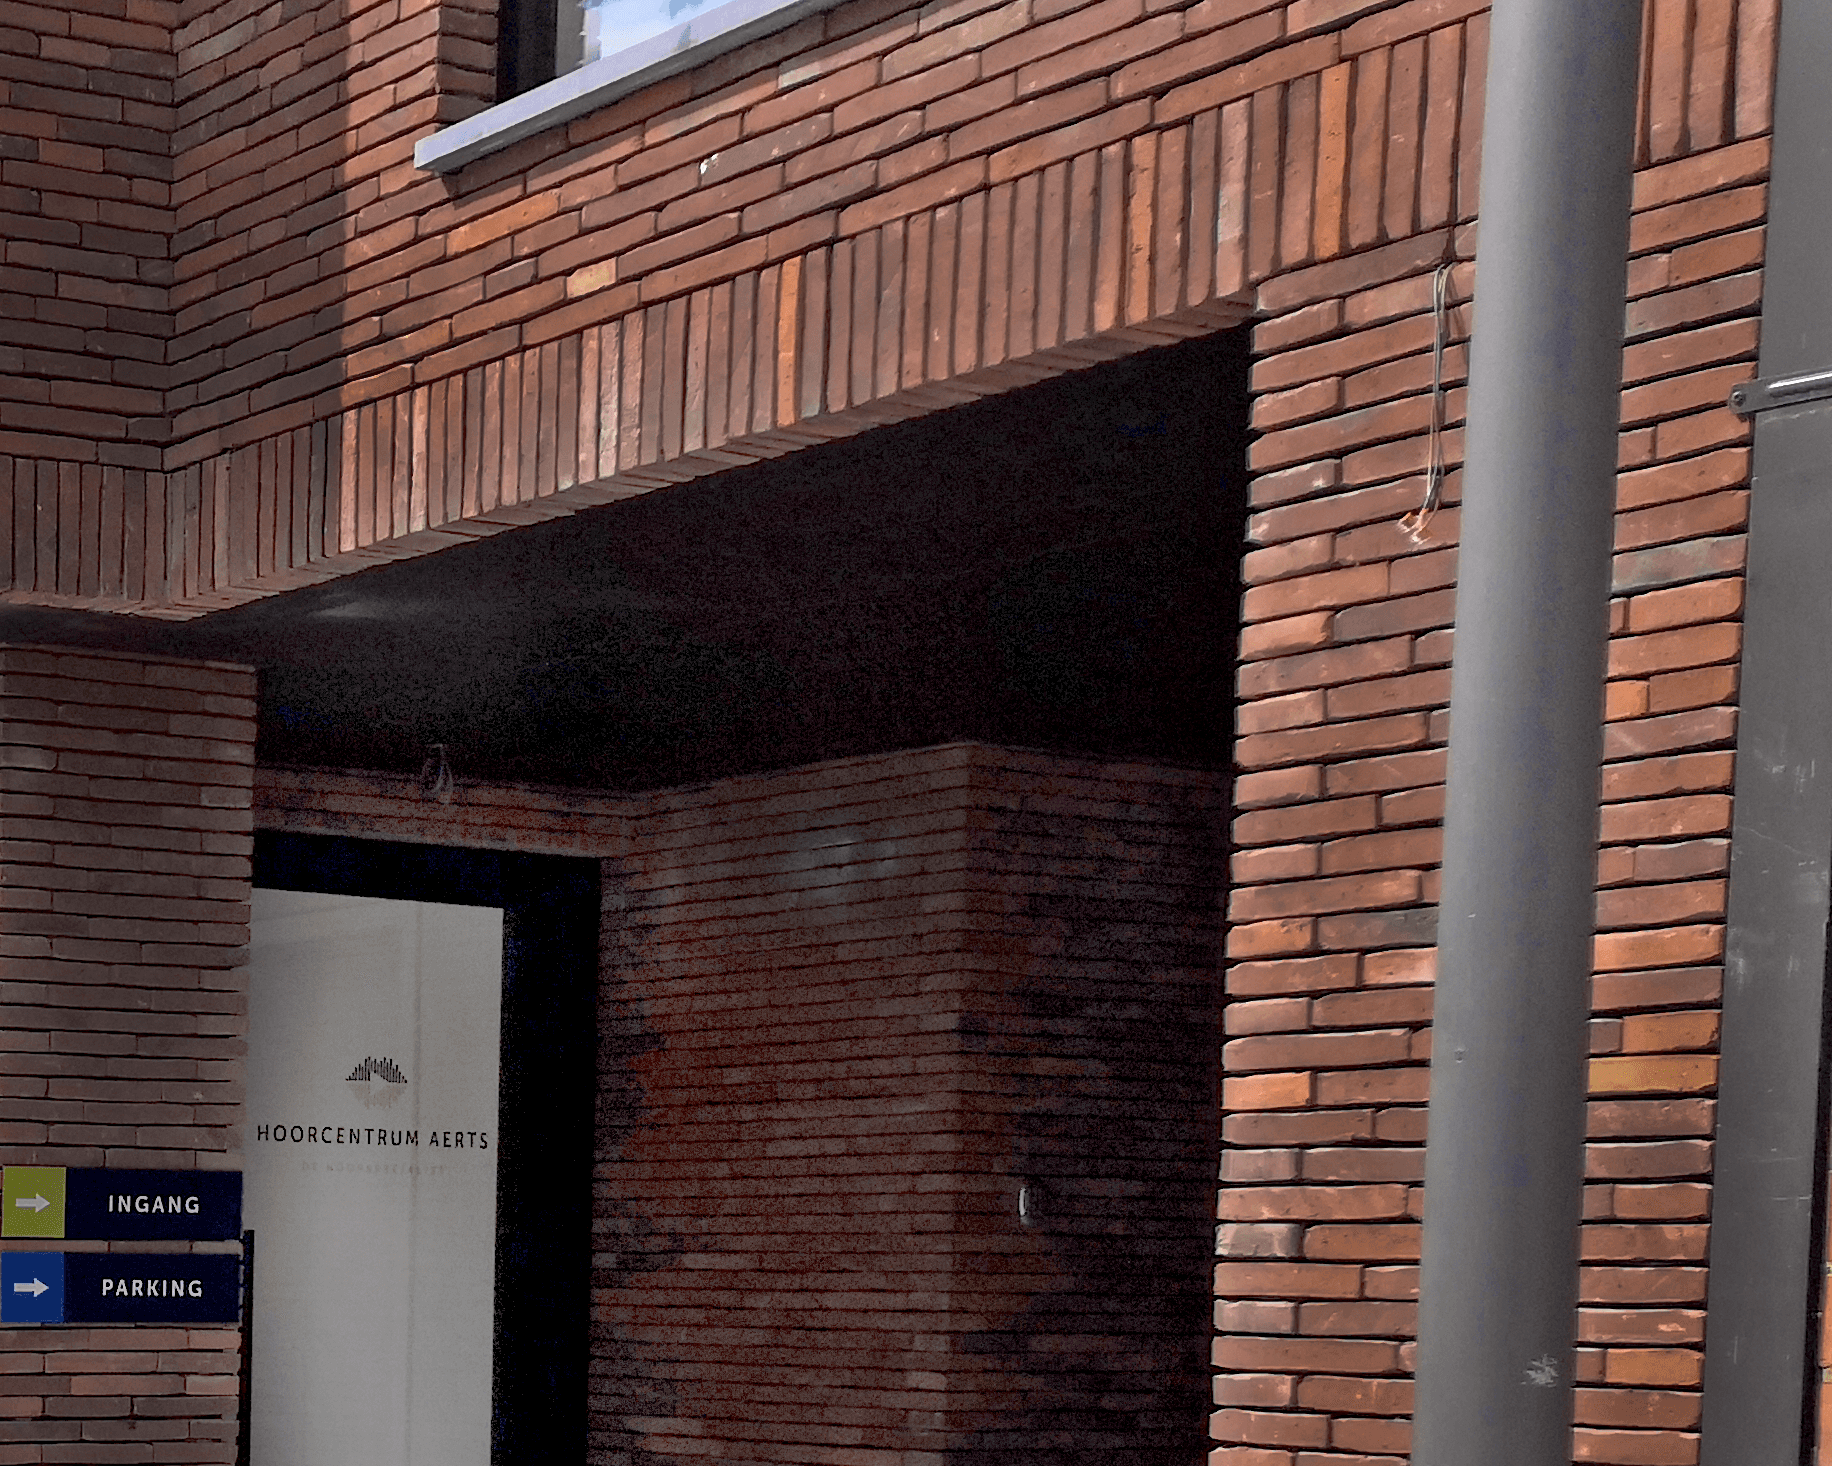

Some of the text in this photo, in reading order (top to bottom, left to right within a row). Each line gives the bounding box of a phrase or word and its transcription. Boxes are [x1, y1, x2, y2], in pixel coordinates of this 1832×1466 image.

[258, 1124, 489, 1150] HOORCENTRUM AERTS
[108, 1194, 201, 1215] INGANG
[101, 1277, 203, 1299] PARKING
